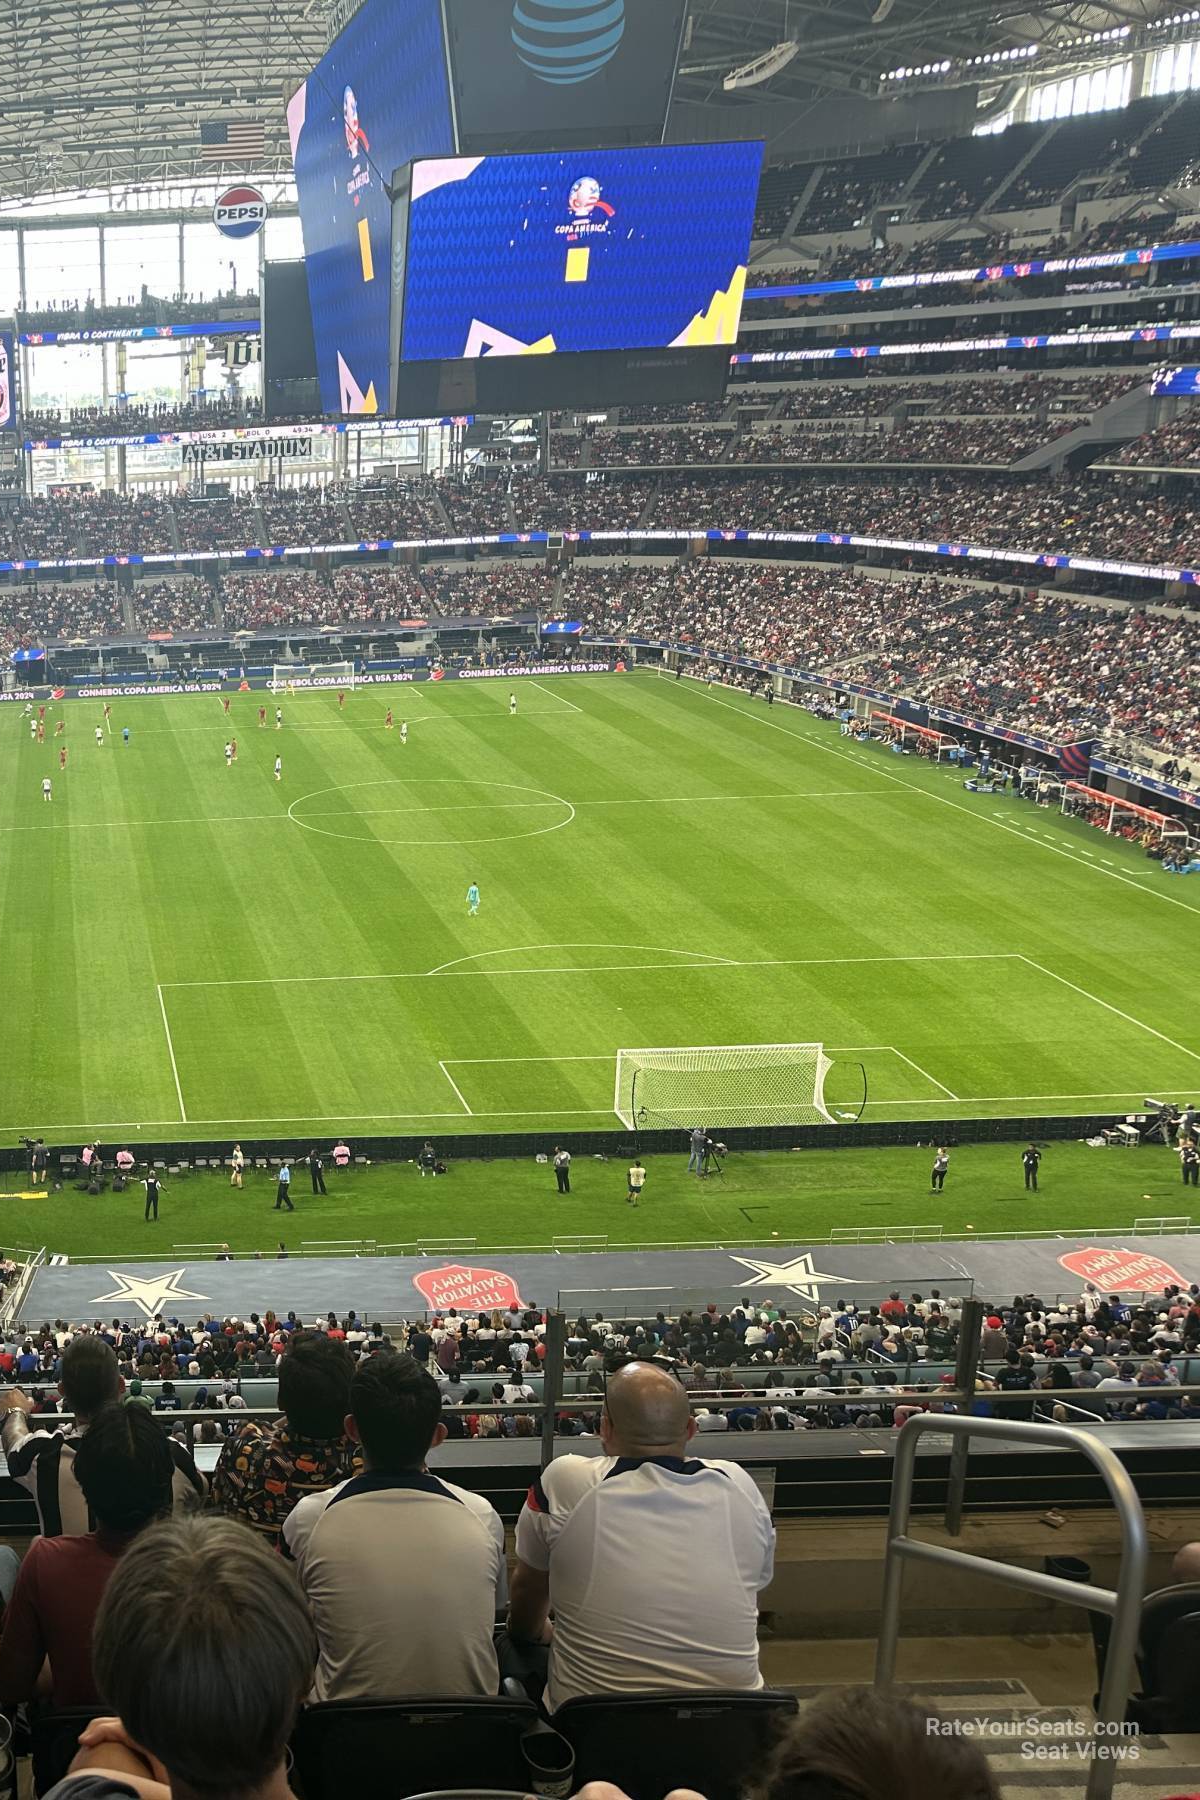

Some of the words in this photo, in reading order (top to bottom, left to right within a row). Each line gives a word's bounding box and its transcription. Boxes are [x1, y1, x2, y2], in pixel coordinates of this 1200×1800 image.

[217, 206, 264, 220] PEPSI
[58, 332, 80, 340] VIBRA
[83, 331, 89, 339] O
[92, 329, 143, 339] CONTINENTE
[221, 340, 261, 369] Lit
[346, 422, 379, 431] ROCKING
[381, 421, 396, 429] THE
[398, 418, 442, 428] CONTINENT
[61, 439, 85, 448] VIBRA
[87, 438, 92, 446] O
[94, 436, 145, 446] CONTINENTE
[183, 444, 228, 463] AT&T
[231, 438, 312, 460] STADIUM
[459, 668, 506, 678] CONMEBOL
[507, 667, 530, 676] COPA
[530, 665, 569, 674] AMERICA
[571, 664, 587, 673] USA
[589, 664, 608, 672] 2024
[266, 678, 313, 688] CONMEBOL
[314, 677, 337, 686] COPA
[337, 675, 374, 684] AMERICA
[375, 674, 391, 682] USA
[393, 673, 412, 682] 2024
[15, 692, 34, 700] 2024
[78, 688, 124, 697] CONMEBOL
[124, 686, 147, 695] COPA
[147, 685, 184, 694] AMERICA
[185, 684, 200, 692] USA
[202, 683, 222, 691] 2024
[1080, 1251, 1122, 1274] ARMY
[1096, 1255, 1164, 1289] SALVATION
[431, 1270, 473, 1293] ARMY
[1135, 1273, 1176, 1291] THE
[434, 1275, 509, 1306] SALVATION
[469, 1291, 505, 1308] THE
[849, 1319, 858, 1330] 10
